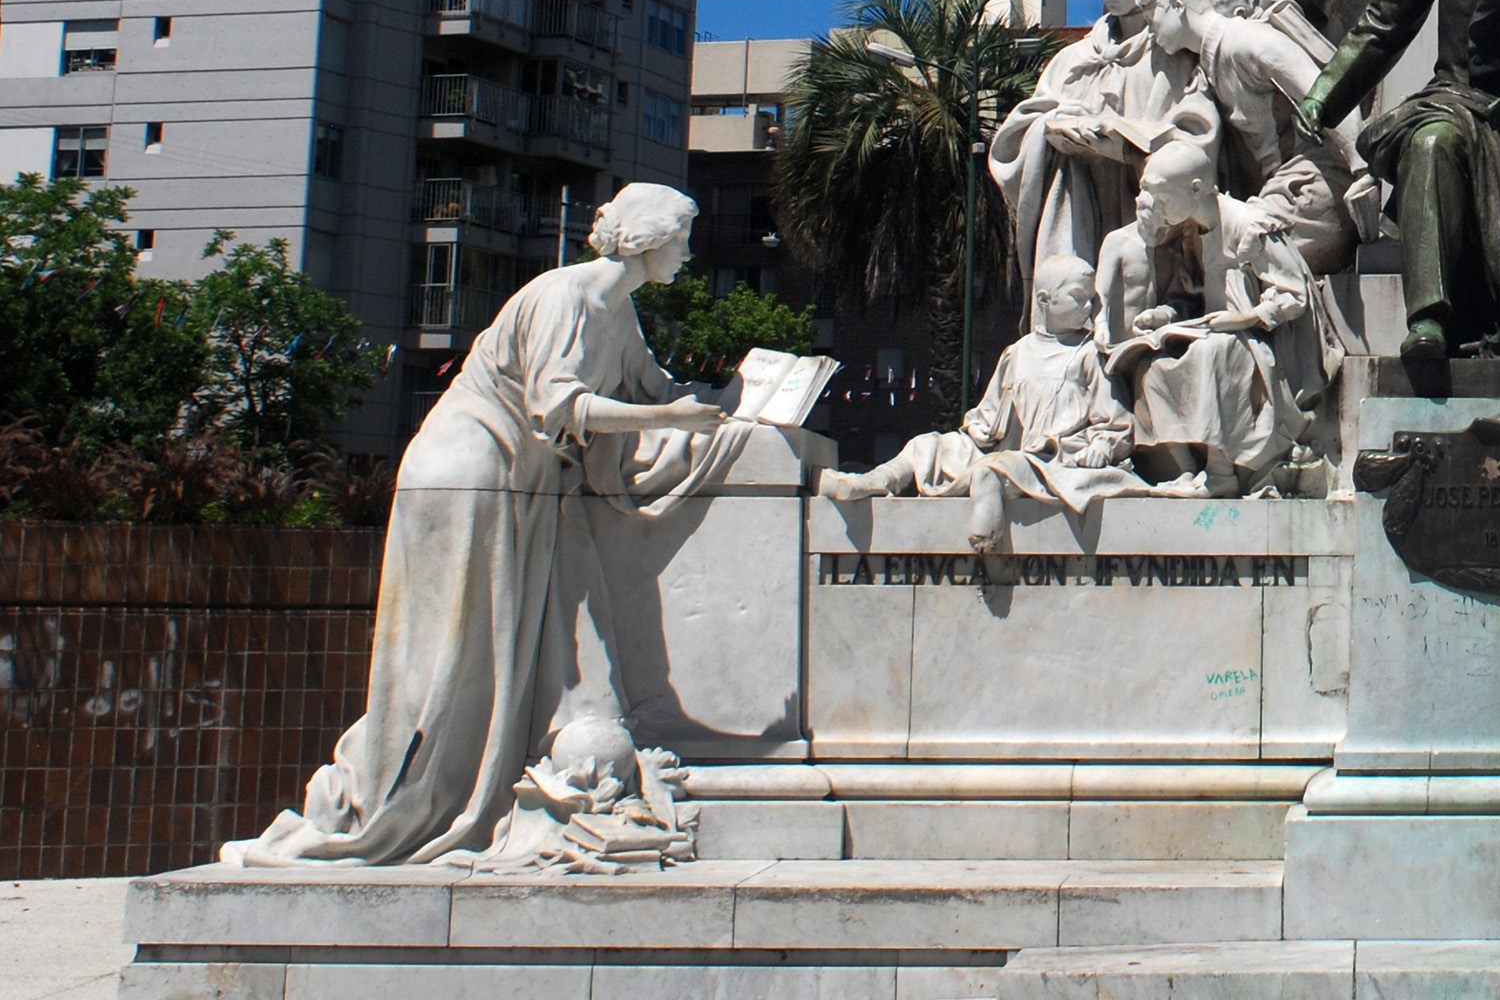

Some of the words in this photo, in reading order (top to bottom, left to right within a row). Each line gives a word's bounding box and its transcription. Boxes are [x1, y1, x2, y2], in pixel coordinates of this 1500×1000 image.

[1423, 487, 1473, 510] JOSE
[832, 554, 873, 585] LA
[1076, 554, 1240, 585] IFVNDIDA
[1251, 554, 1295, 585] EN
[1205, 668, 1258, 685] VARELA
